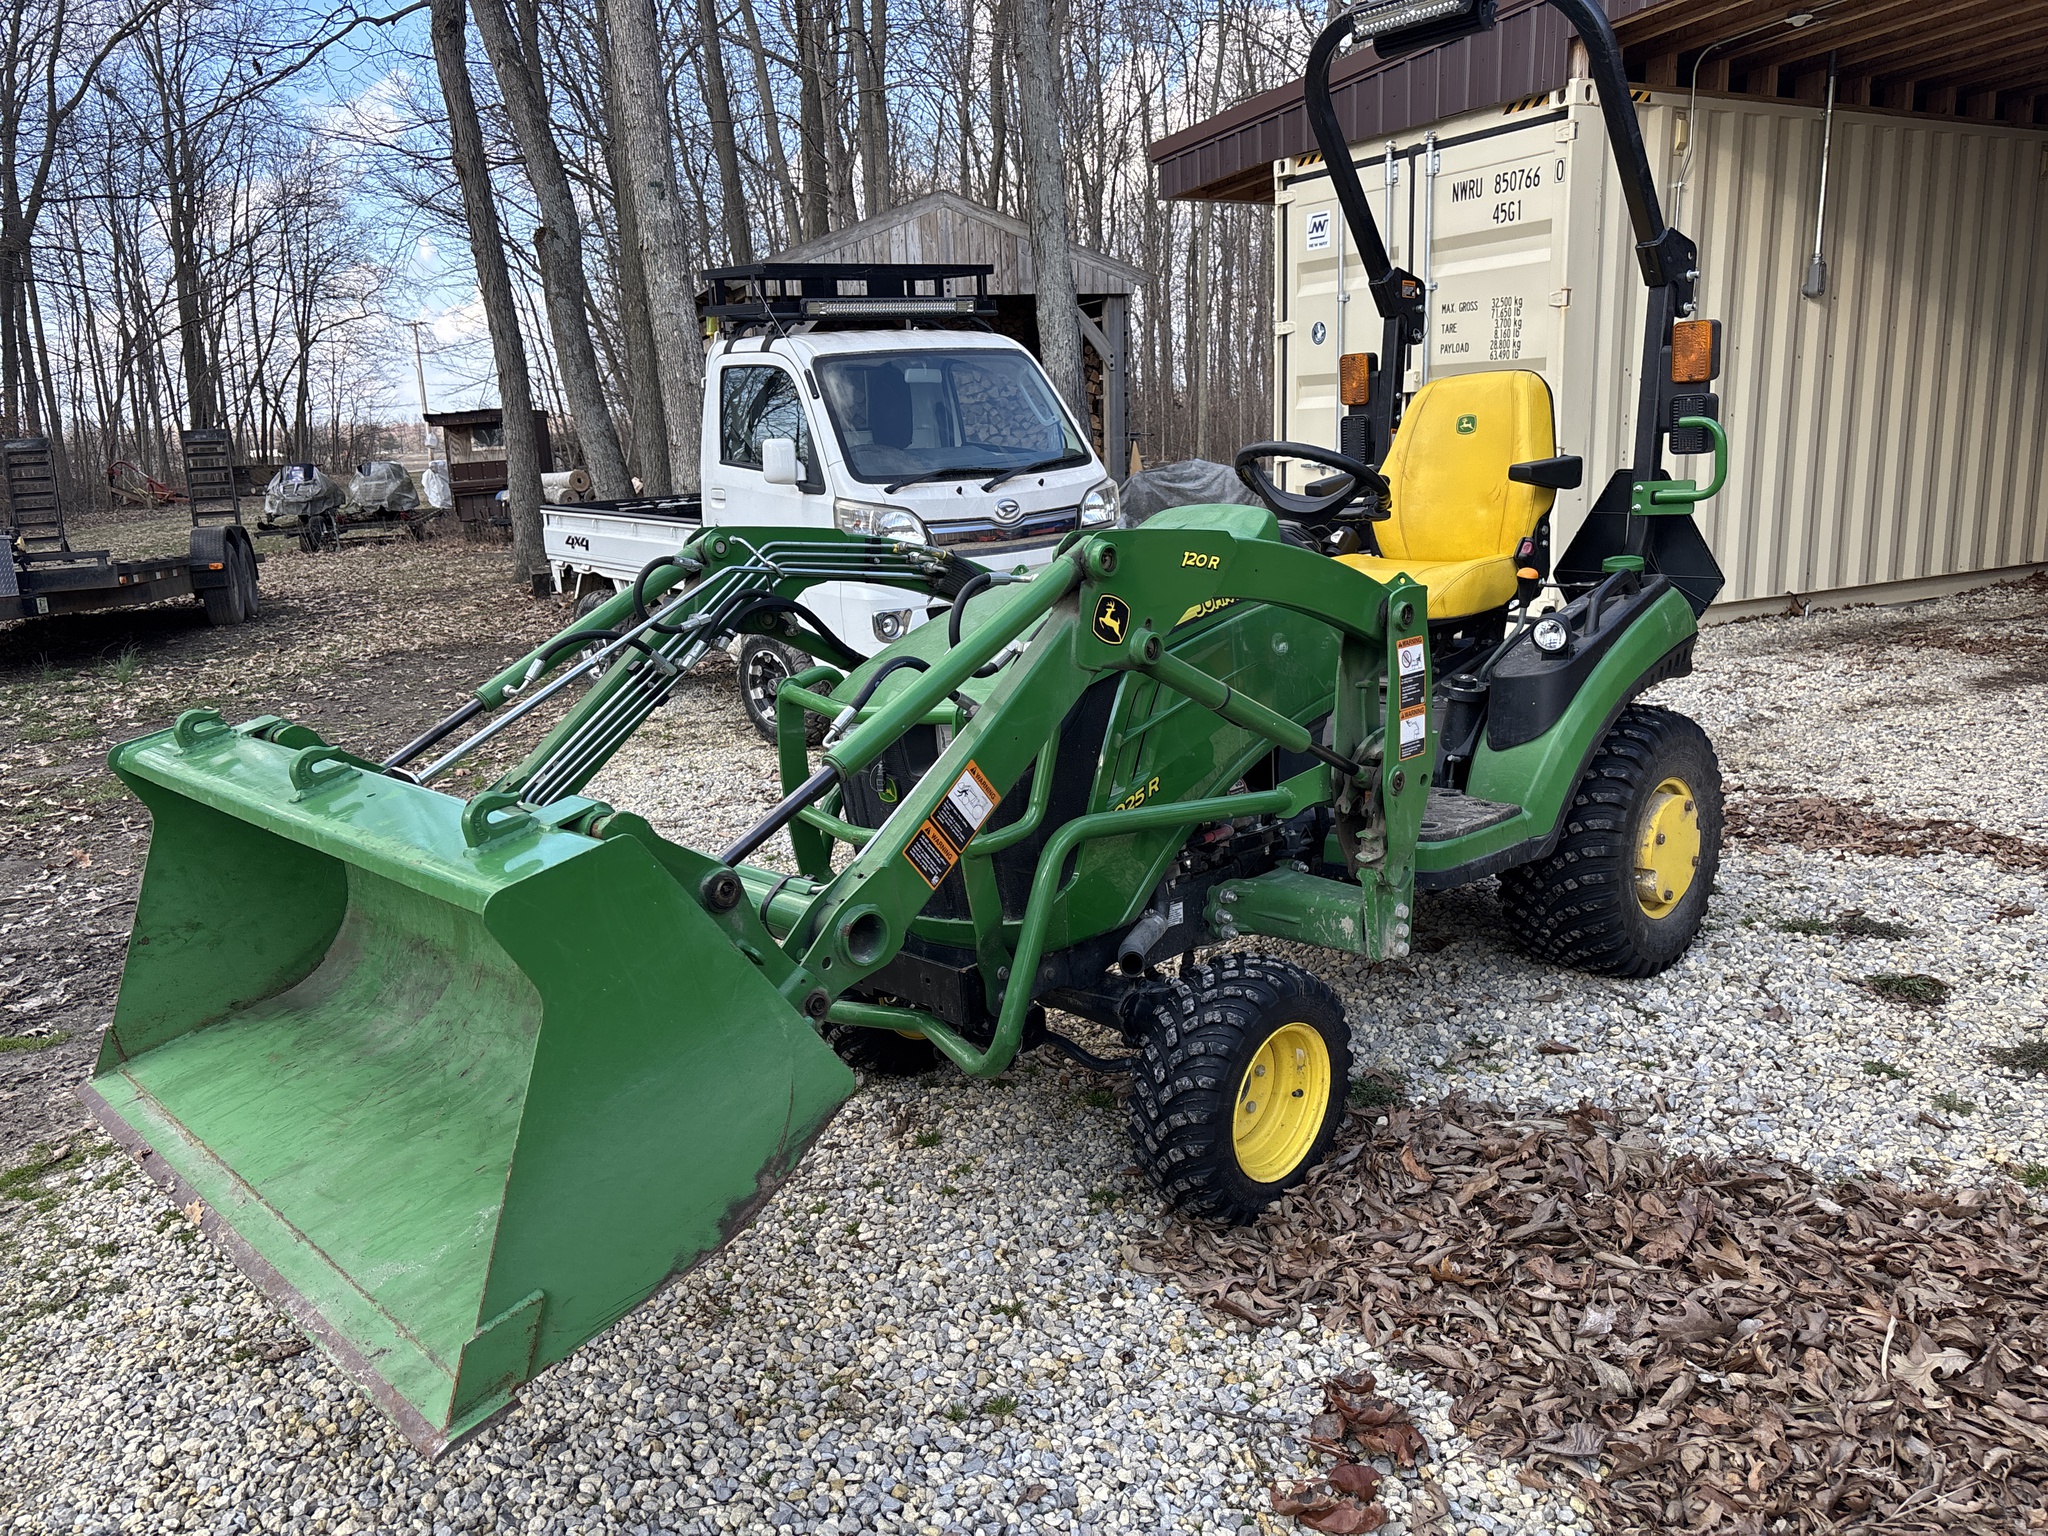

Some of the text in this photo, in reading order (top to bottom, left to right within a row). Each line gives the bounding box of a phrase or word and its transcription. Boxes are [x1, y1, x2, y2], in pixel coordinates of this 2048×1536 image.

[1452, 177, 1483, 203] NWRU
[1494, 166, 1541, 194] 850766
[1492, 199, 1521, 224] 45G1
[1458, 301, 1478, 313] GROSS
[1514, 296, 1523, 309] kg
[1514, 307, 1521, 317] lb
[1441, 323, 1457, 334] TARE
[1513, 318, 1522, 330] kg
[1513, 328, 1520, 338] lb
[1440, 342, 1470, 354] PAYLOAD
[1512, 339, 1521, 351] kg
[1511, 349, 1519, 359] lb
[975, 772, 997, 800] WARNING
[930, 832, 953, 861] WARNING
